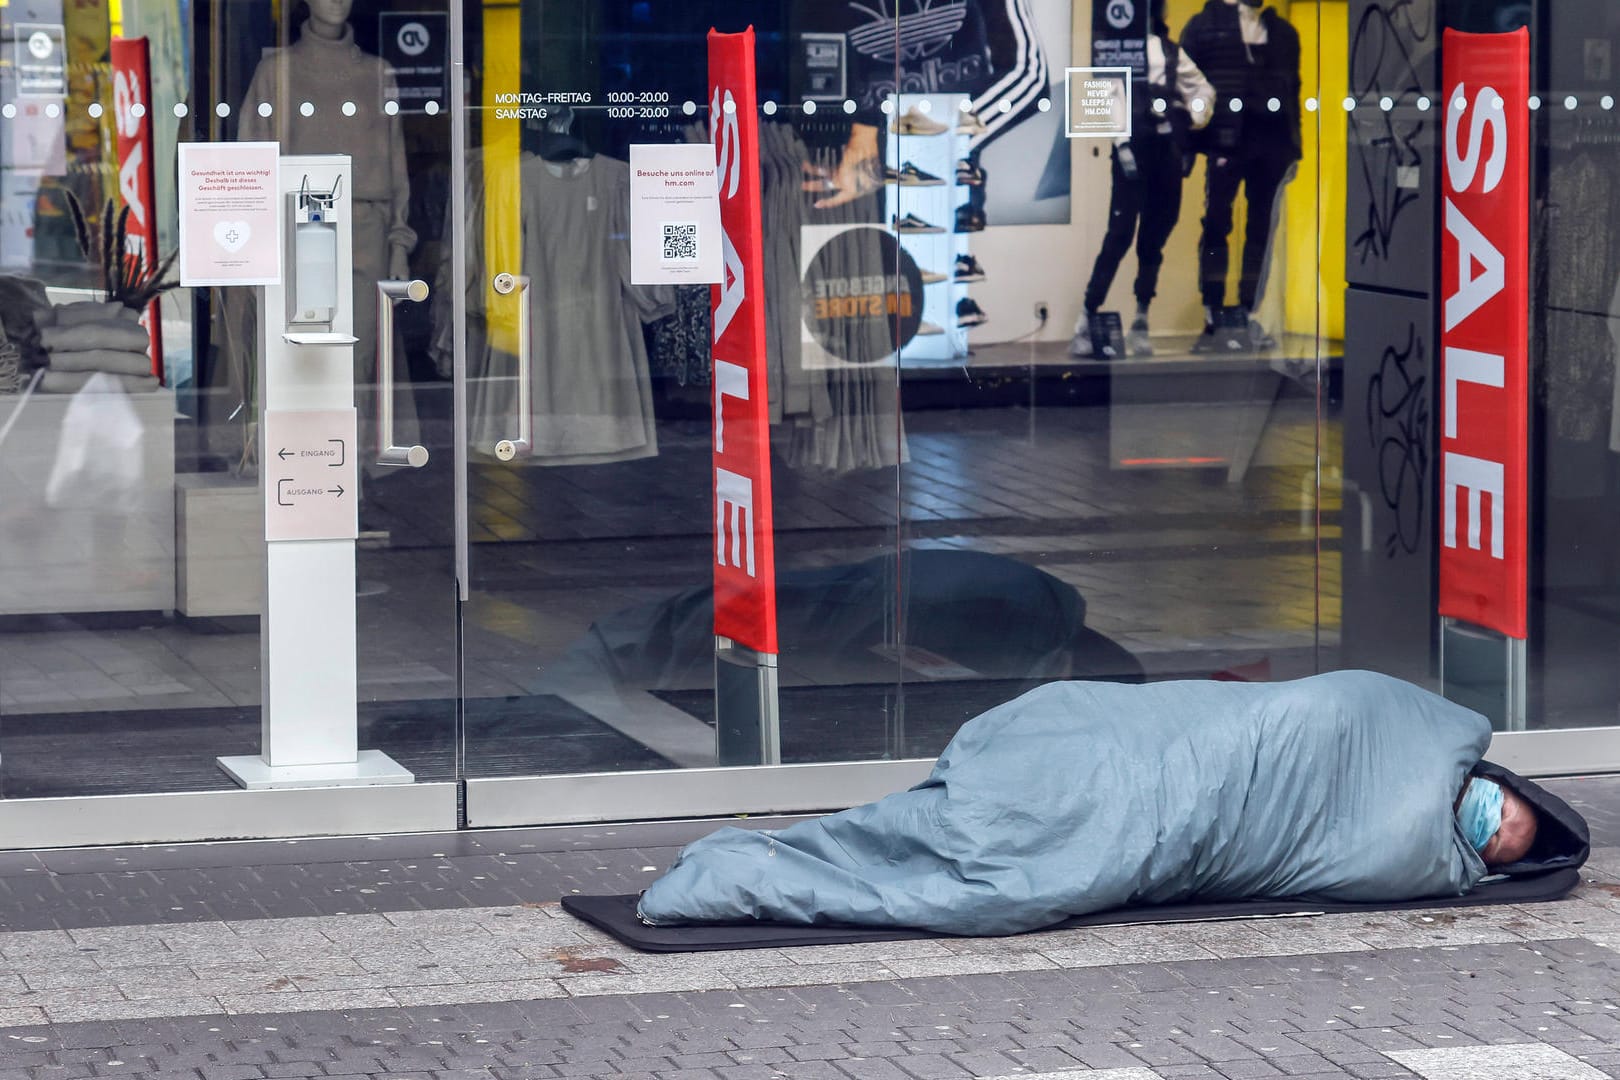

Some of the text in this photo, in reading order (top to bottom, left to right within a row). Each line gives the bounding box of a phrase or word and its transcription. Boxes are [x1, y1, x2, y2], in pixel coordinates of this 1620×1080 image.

[1083, 80, 1112, 89] FASHION
[1087, 89, 1108, 98] NEVER
[1081, 98, 1114, 107] SLEEPS AT
[495, 108, 548, 120] SAMSTAG
[1084, 107, 1111, 116] HM.COM
[246, 169, 271, 177] wichtig!
[637, 169, 669, 177] Besuche
[684, 169, 705, 177] online
[1445, 82, 1507, 559] SALE
[711, 86, 755, 578] SALE
[286, 488, 324, 496] AUSGANG
